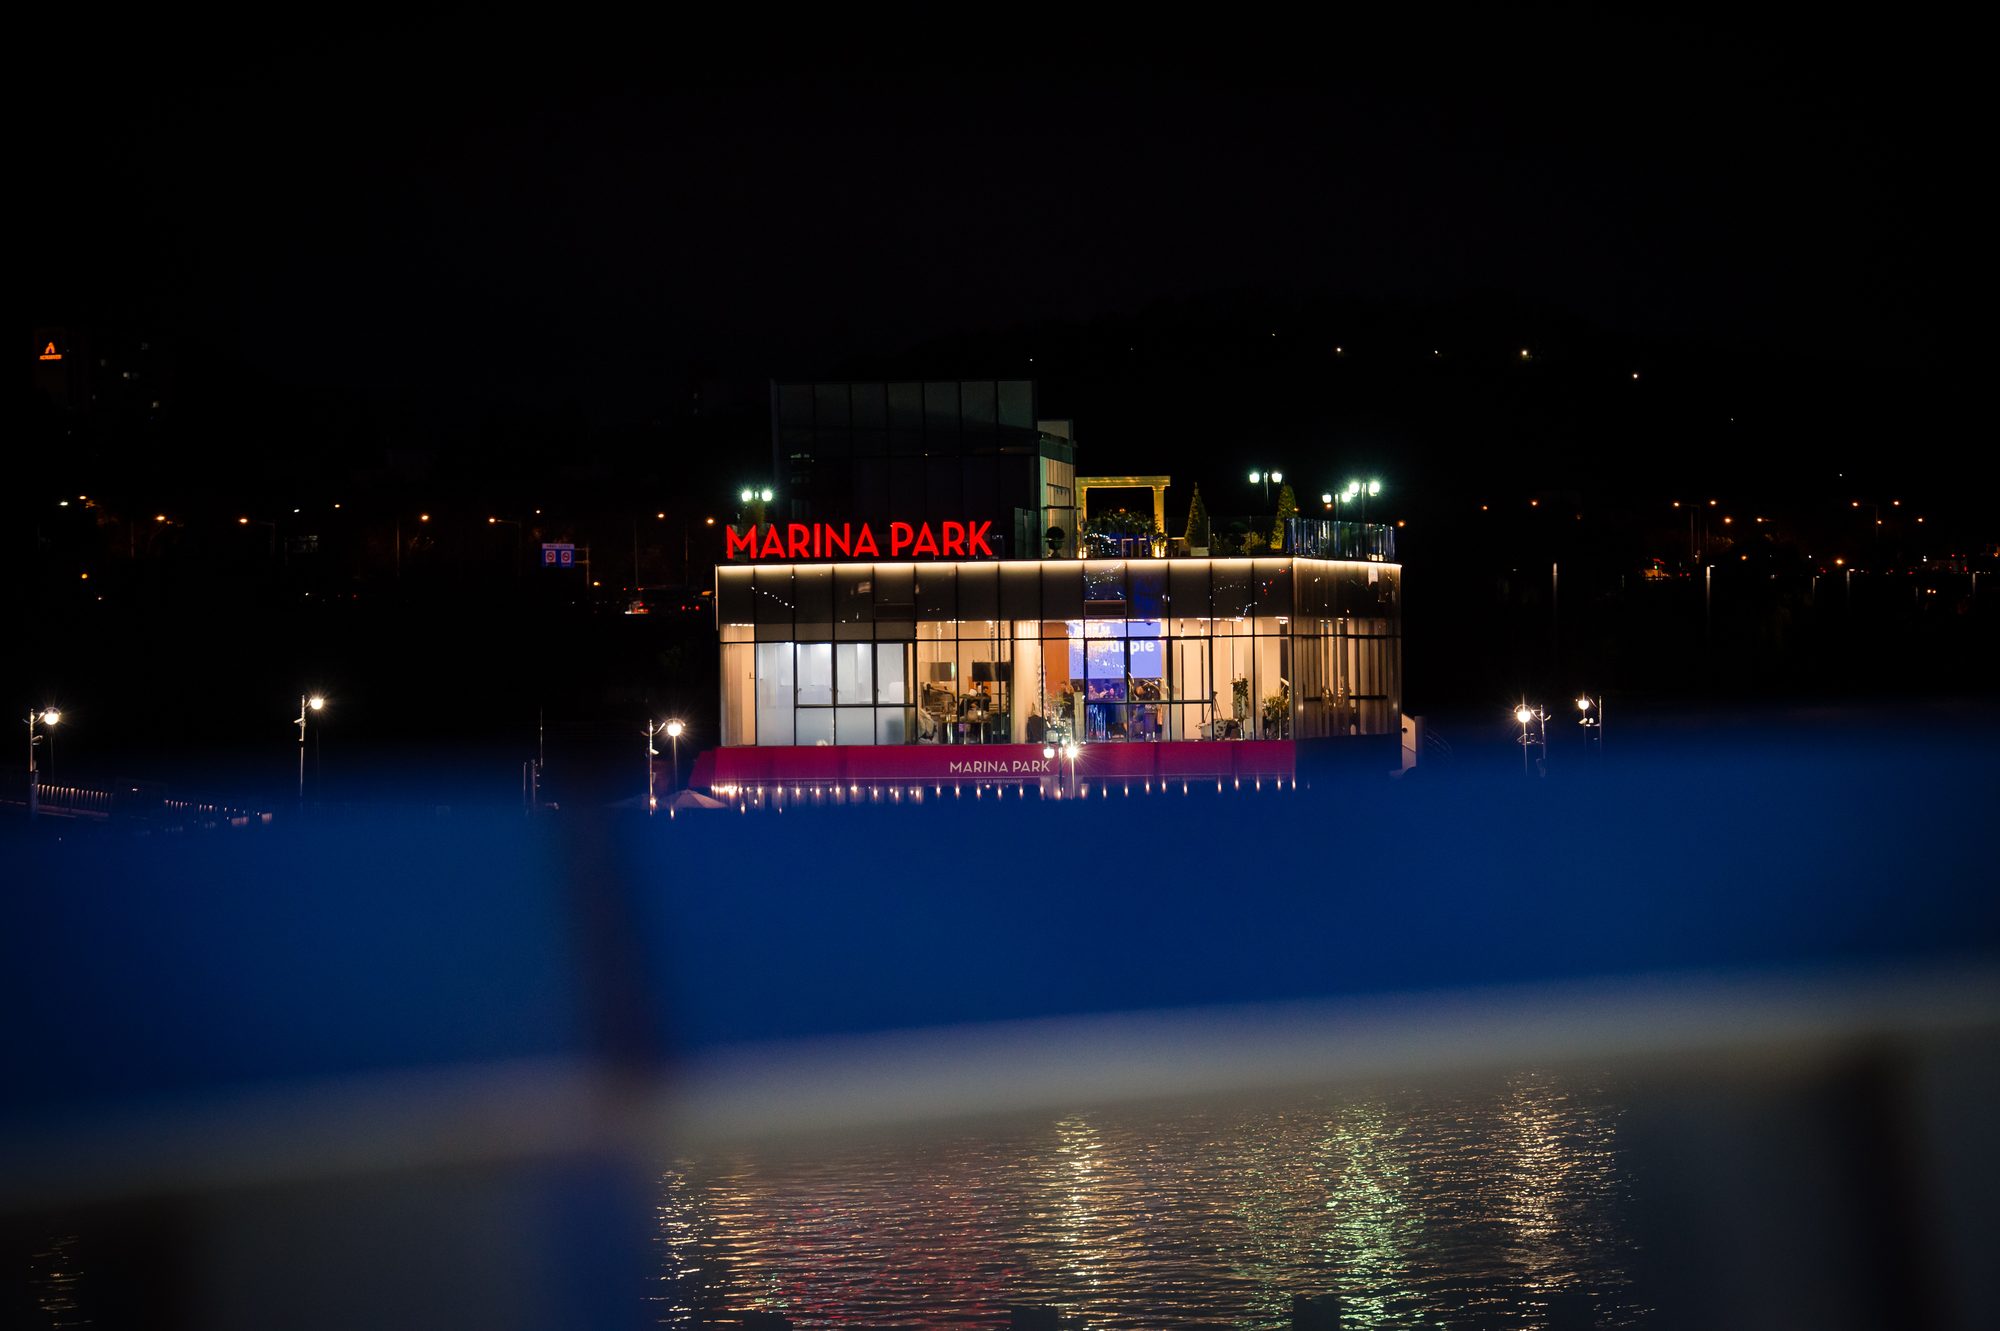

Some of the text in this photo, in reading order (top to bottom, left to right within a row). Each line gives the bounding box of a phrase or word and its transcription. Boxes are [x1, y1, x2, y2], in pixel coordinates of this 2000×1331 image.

[726, 521, 992, 559] MARINA PARK
[949, 760, 1050, 773] MARINA PARK
